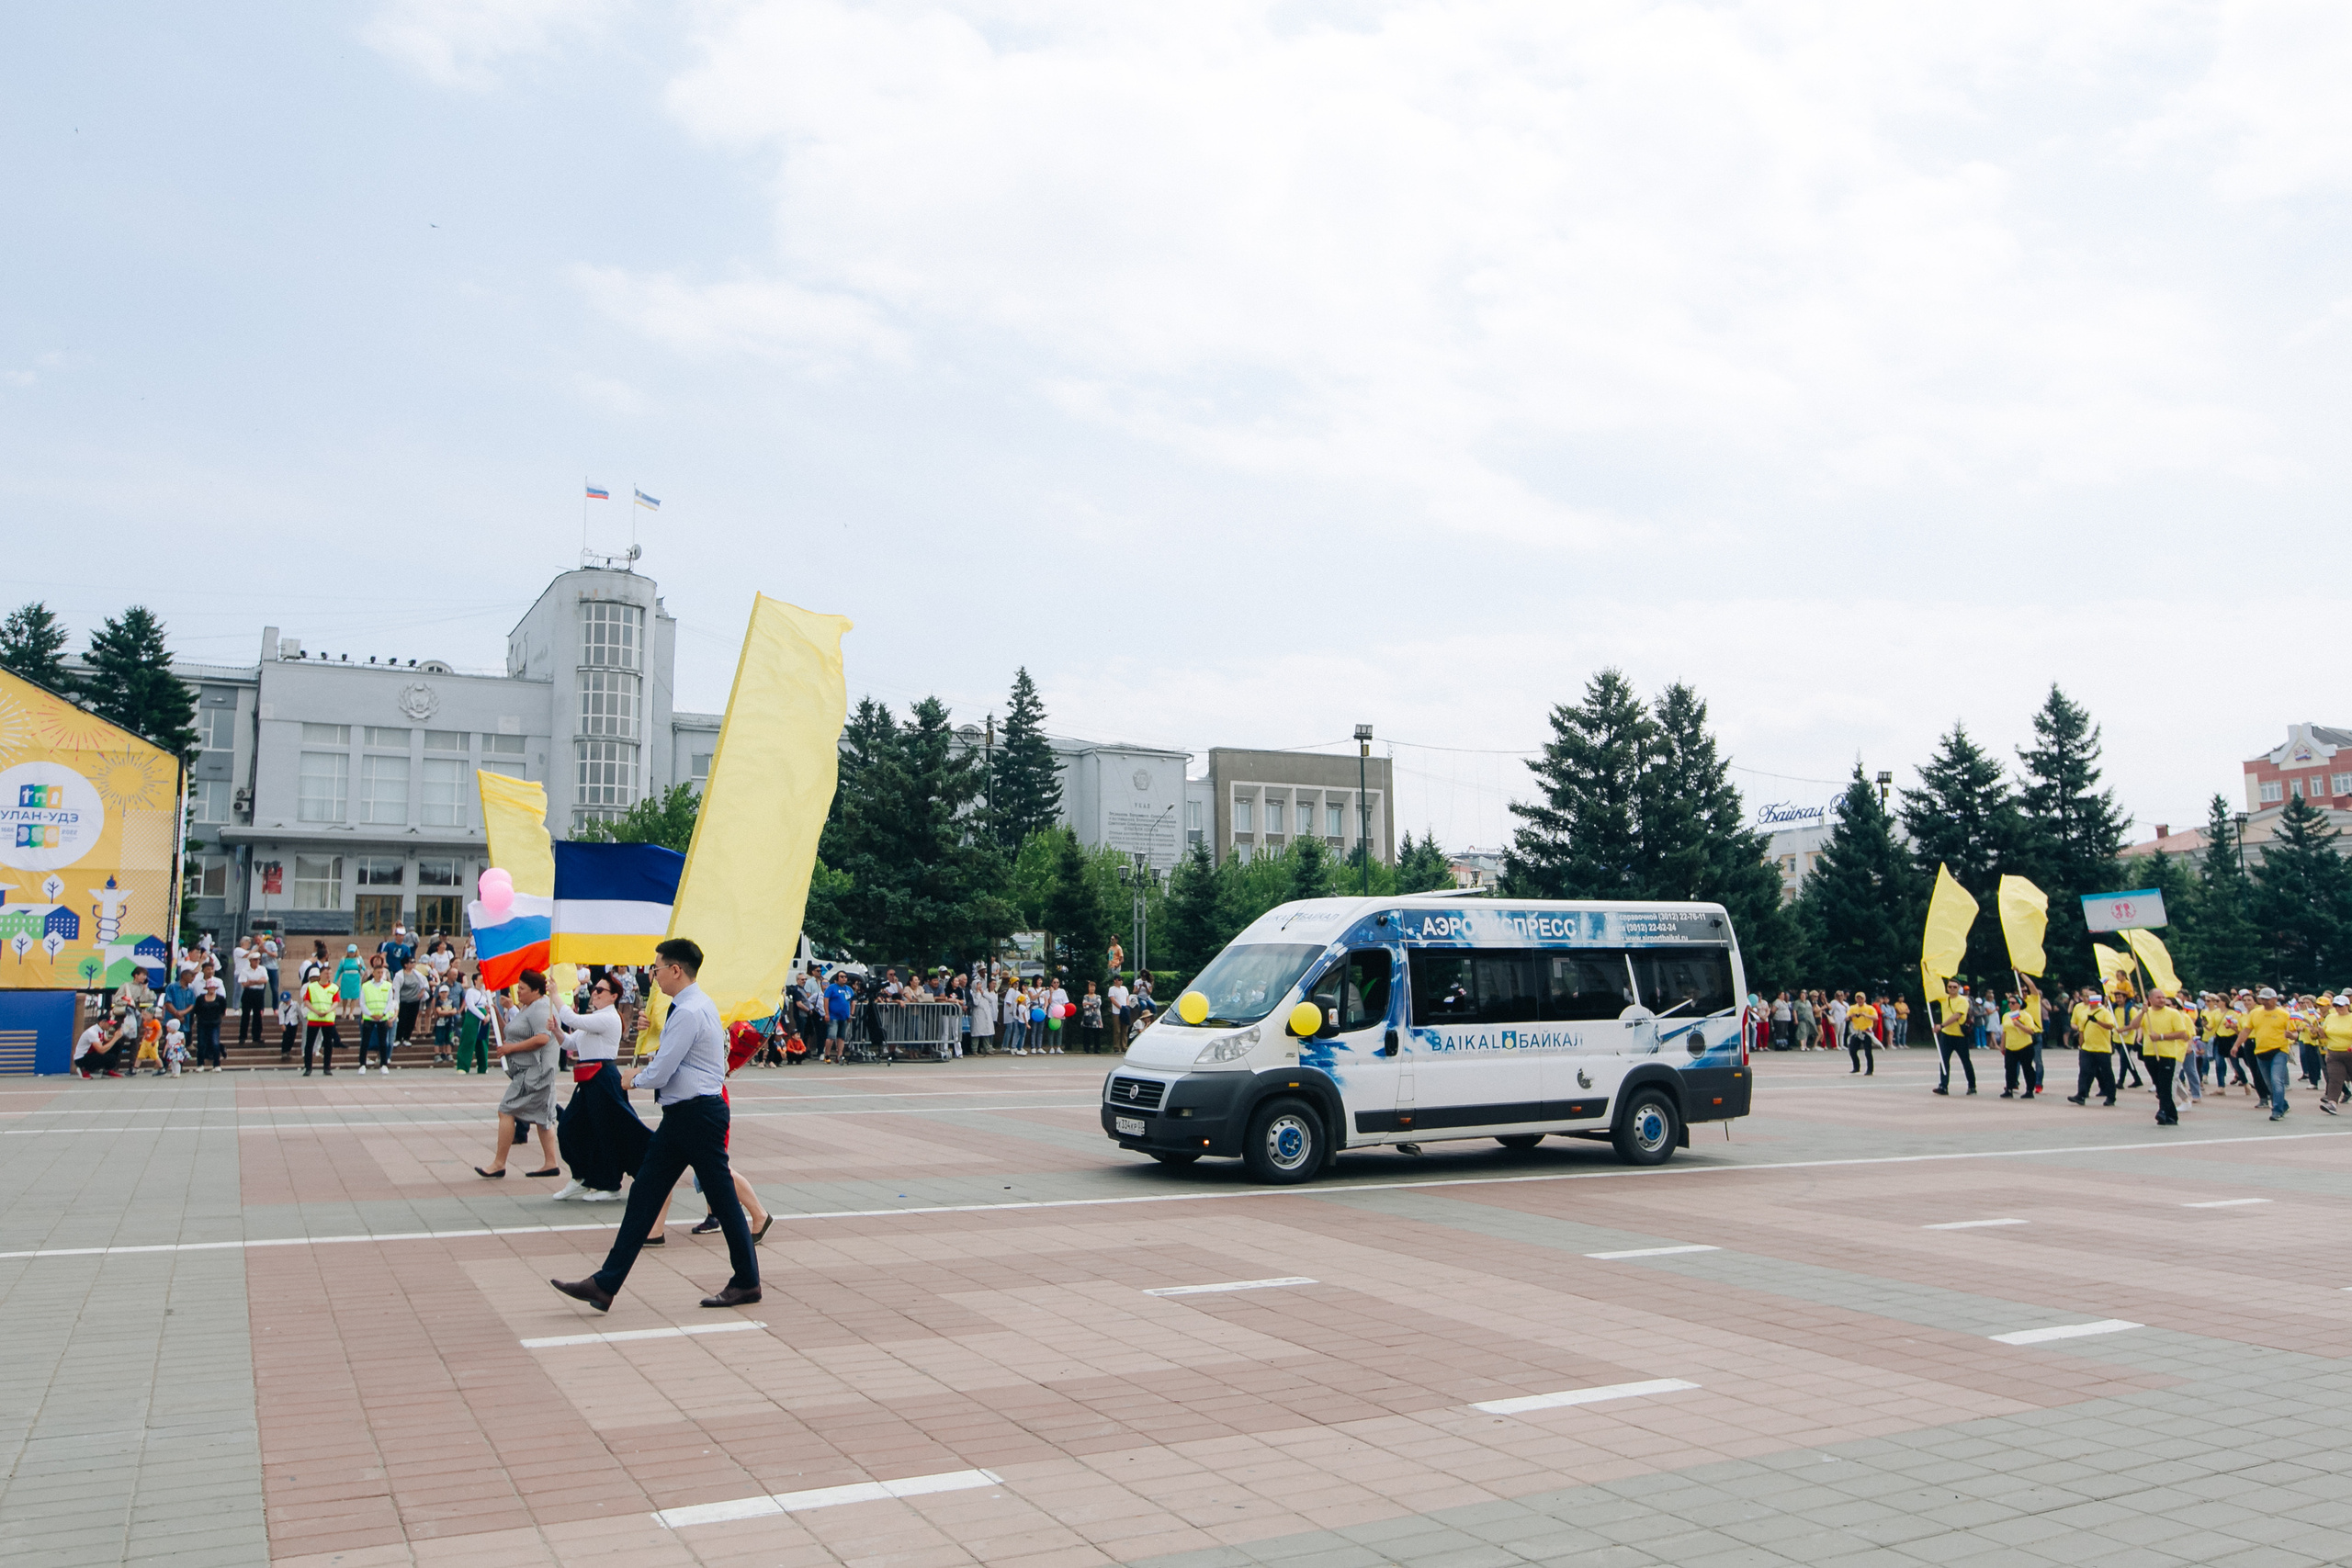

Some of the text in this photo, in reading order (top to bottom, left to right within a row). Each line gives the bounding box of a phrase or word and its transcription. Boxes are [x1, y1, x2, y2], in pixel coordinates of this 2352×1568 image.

[0, 810, 79, 824] УЛАН-УДЭ
[1758, 800, 1825, 825] Байкал
[1657, 912, 1679, 922] (3012)
[1422, 917, 1577, 937] АЭРОСПРЕСС
[1626, 923, 1647, 933] (3012)
[1648, 922, 1677, 931] 22-62-24
[1431, 1034, 1500, 1051] BAIKAL
[1519, 1030, 1583, 1049] БАЙКАЛ
